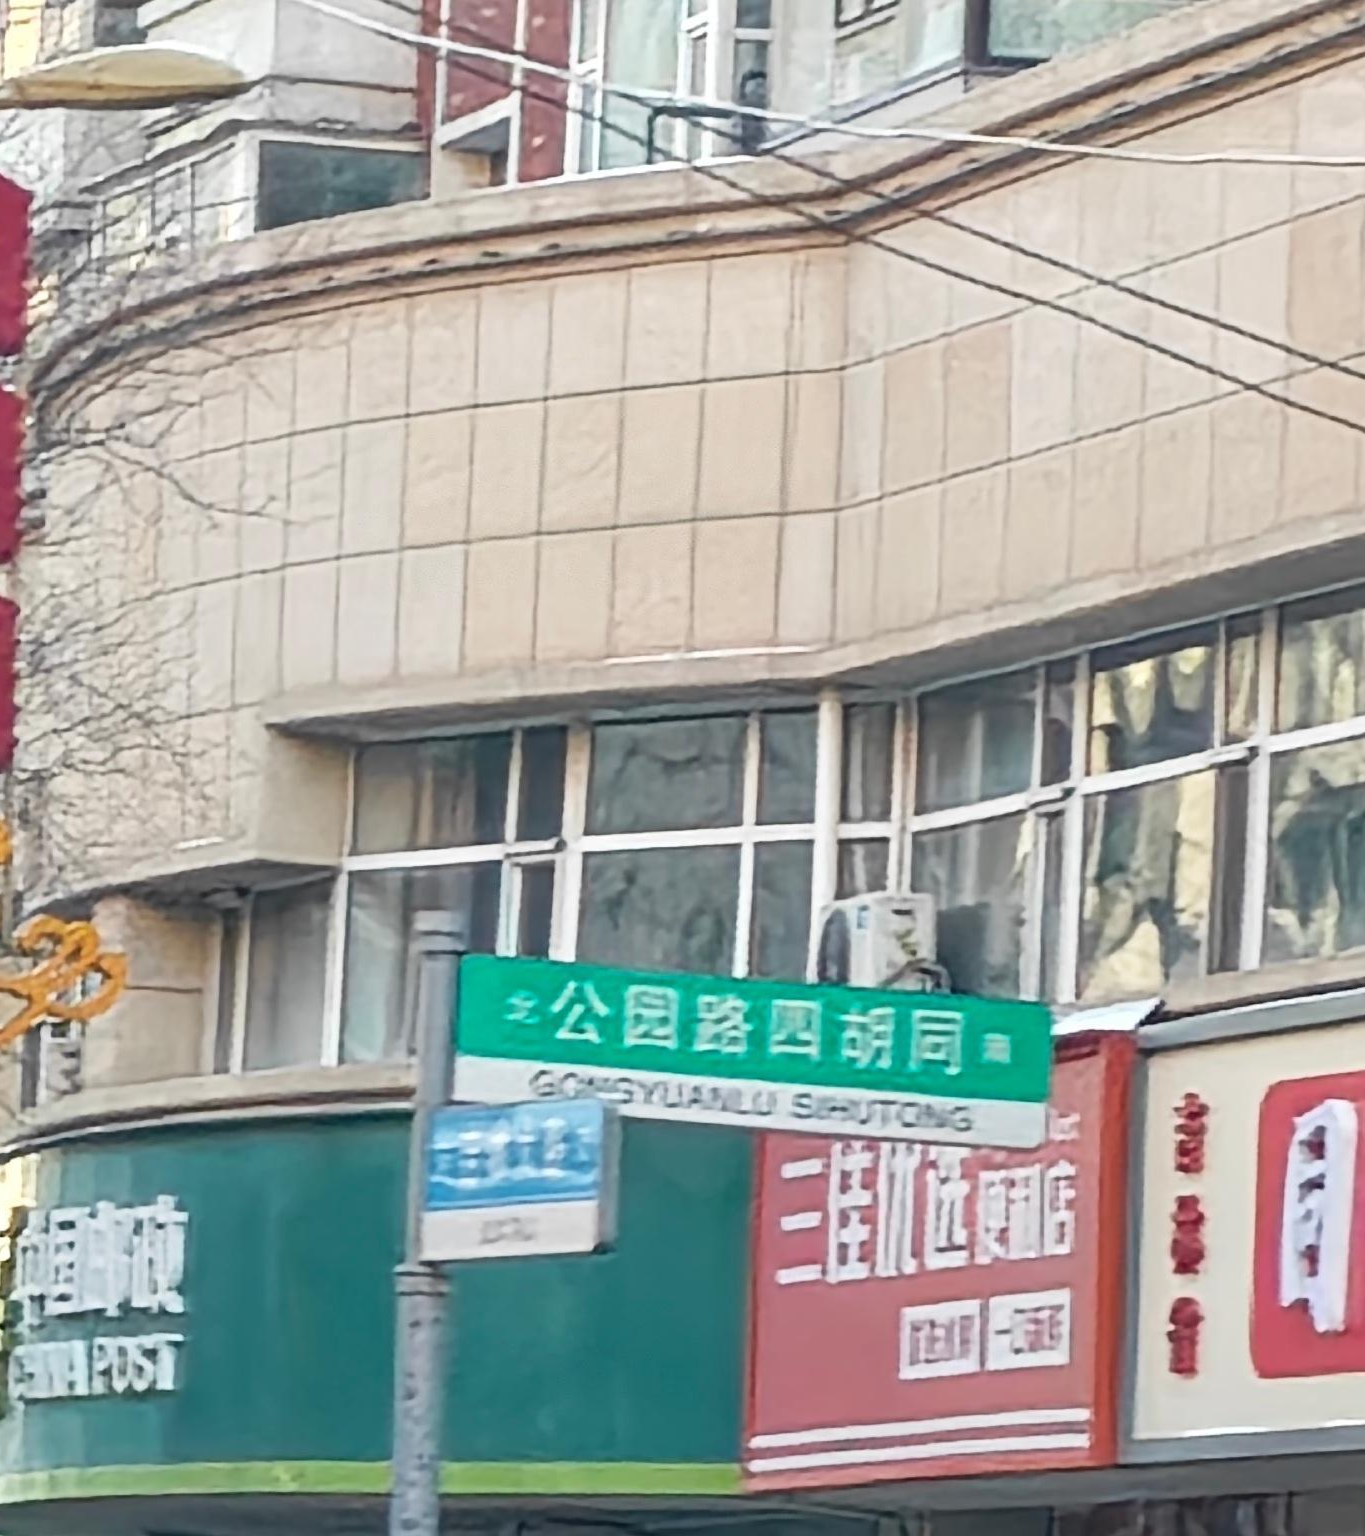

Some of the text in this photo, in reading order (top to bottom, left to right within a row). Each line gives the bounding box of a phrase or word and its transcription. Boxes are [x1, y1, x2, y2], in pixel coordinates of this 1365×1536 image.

[549, 979, 964, 1076] 公园路四胡同
[92, 1332, 185, 1396] POST
